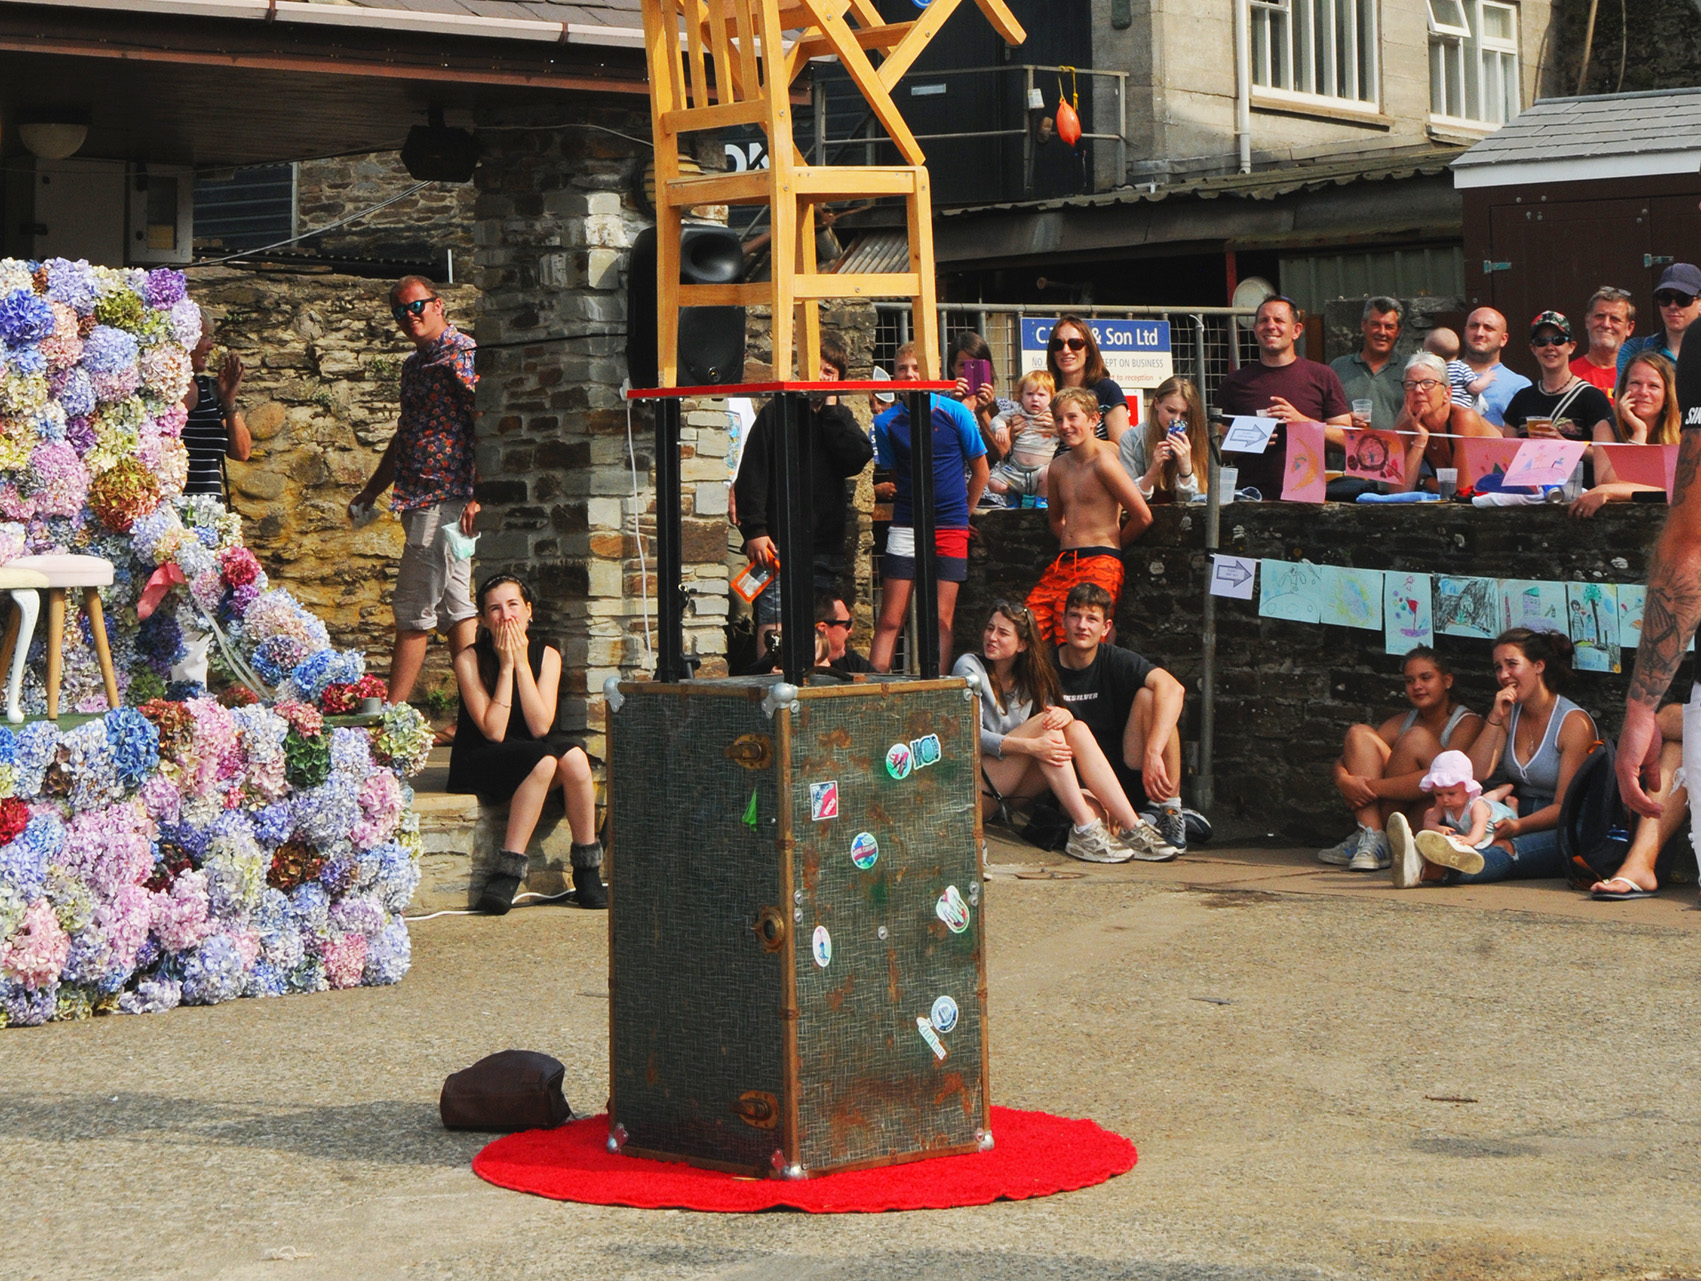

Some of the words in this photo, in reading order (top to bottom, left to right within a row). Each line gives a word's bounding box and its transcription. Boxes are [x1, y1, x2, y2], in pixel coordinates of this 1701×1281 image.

[1094, 327, 1102, 344] &
[1106, 328, 1132, 345] Son
[1136, 328, 1159, 346] Ltd
[1032, 357, 1043, 367] NO
[1104, 358, 1117, 367] EPT
[1119, 358, 1130, 368] ON
[1131, 358, 1164, 368] BUSINESS
[1124, 374, 1154, 383] reception
